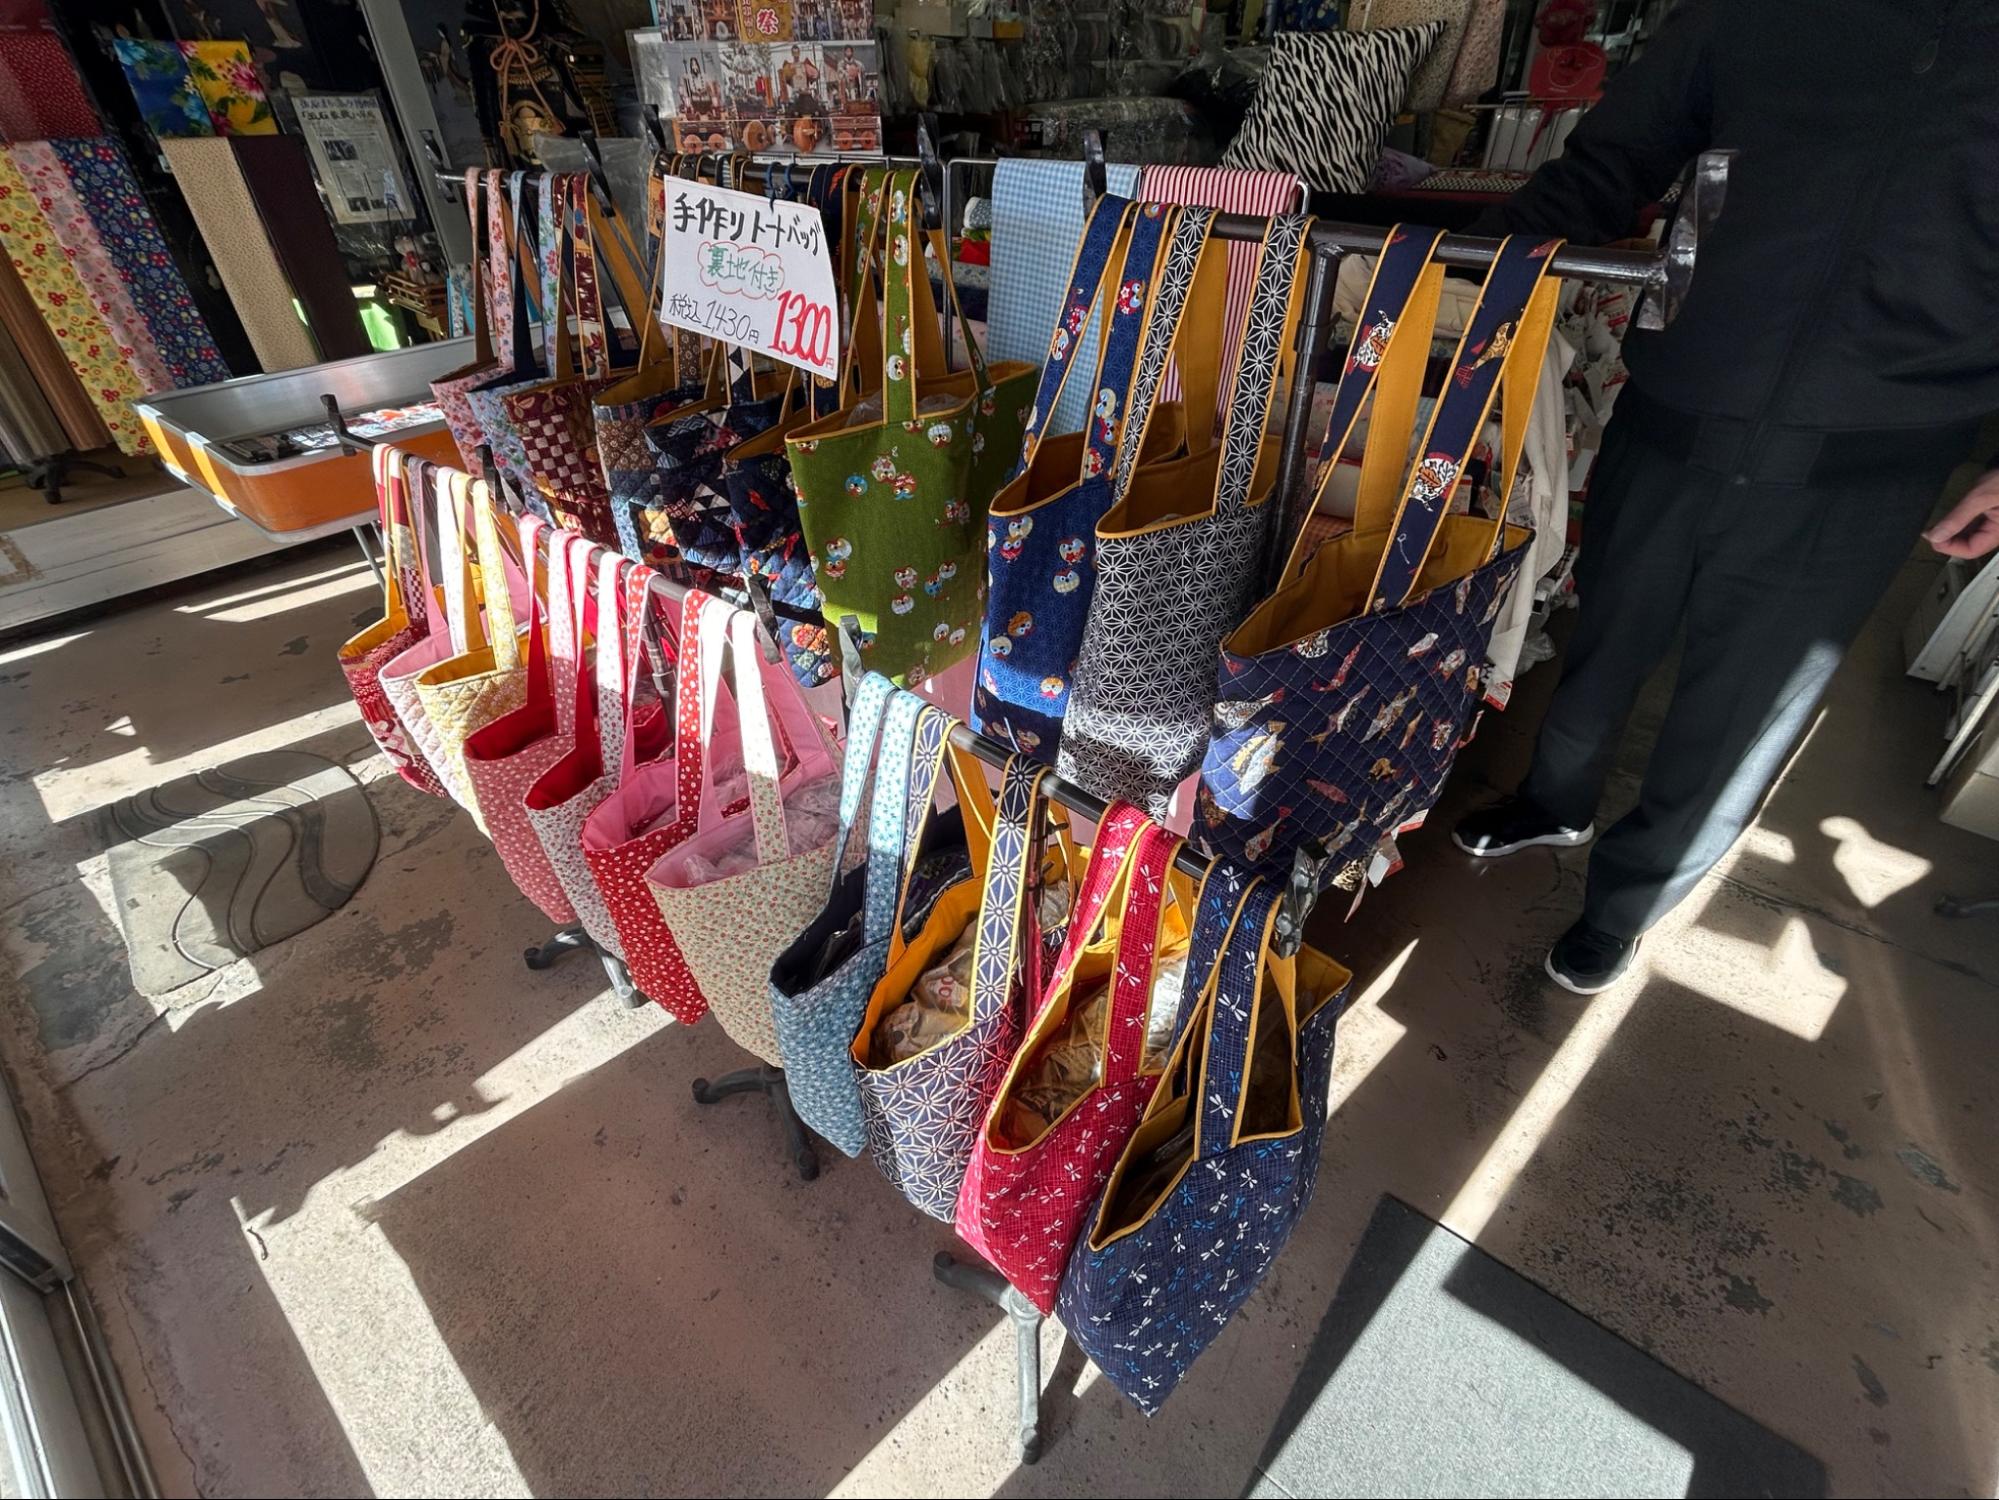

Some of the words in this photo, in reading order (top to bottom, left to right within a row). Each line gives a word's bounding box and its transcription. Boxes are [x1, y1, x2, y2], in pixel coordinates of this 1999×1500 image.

[757, 8, 779, 35] 祭
[706, 247, 779, 293] 裏地付き
